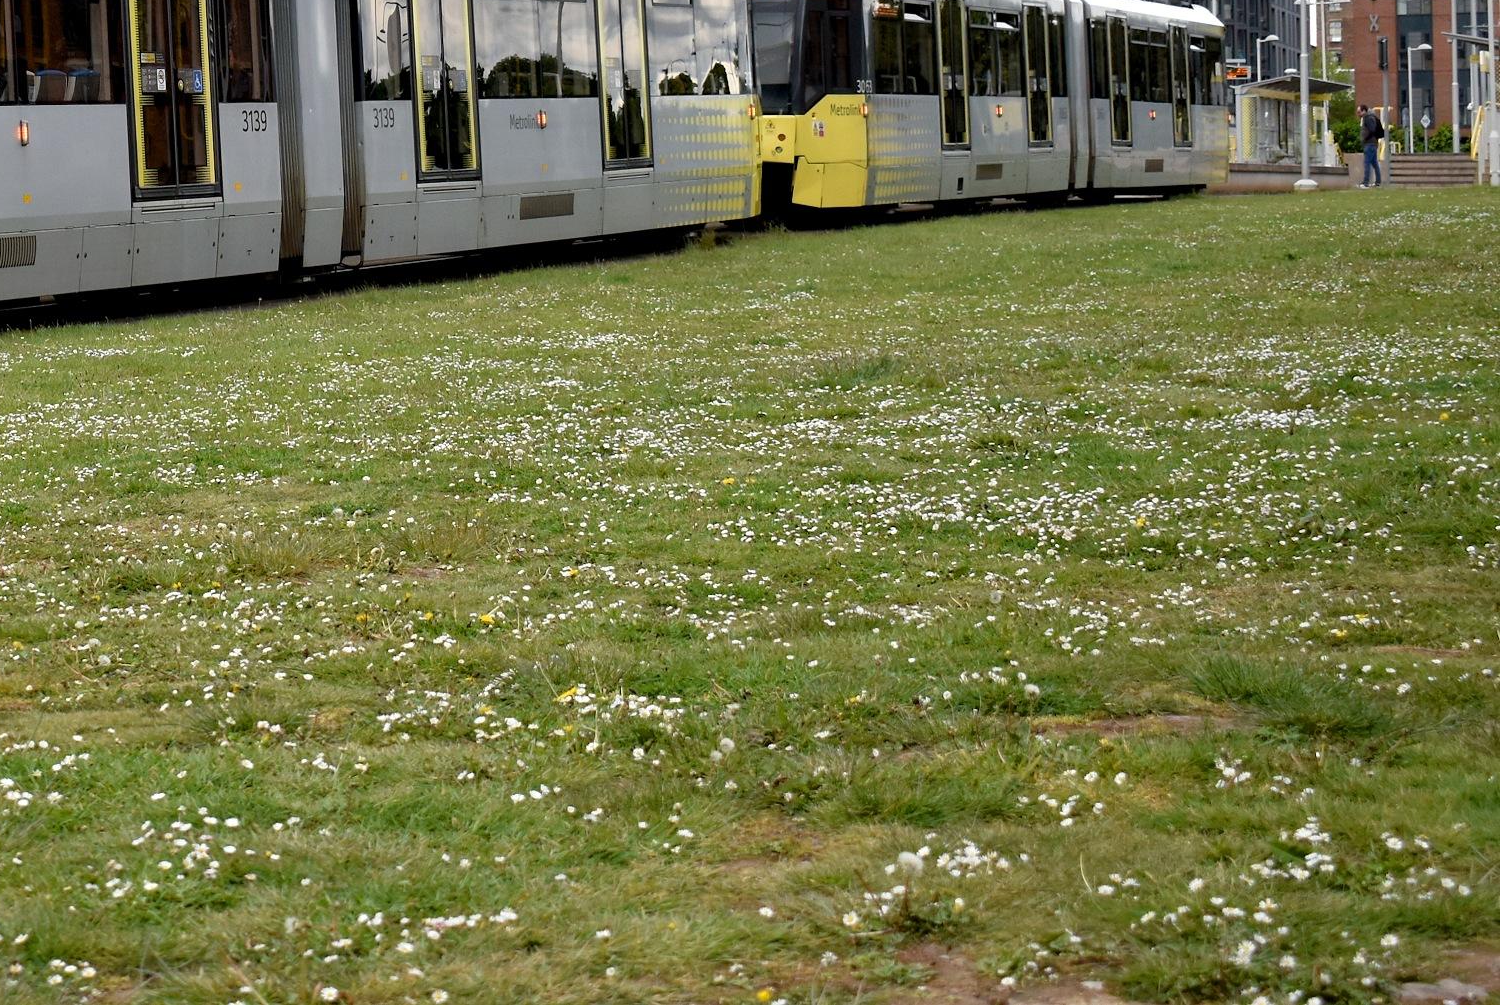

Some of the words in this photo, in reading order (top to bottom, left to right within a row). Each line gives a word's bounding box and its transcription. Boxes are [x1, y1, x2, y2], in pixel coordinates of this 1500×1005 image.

[241, 109, 268, 133] 3139
[372, 107, 395, 129] 3139
[509, 113, 537, 130] Metrolin
